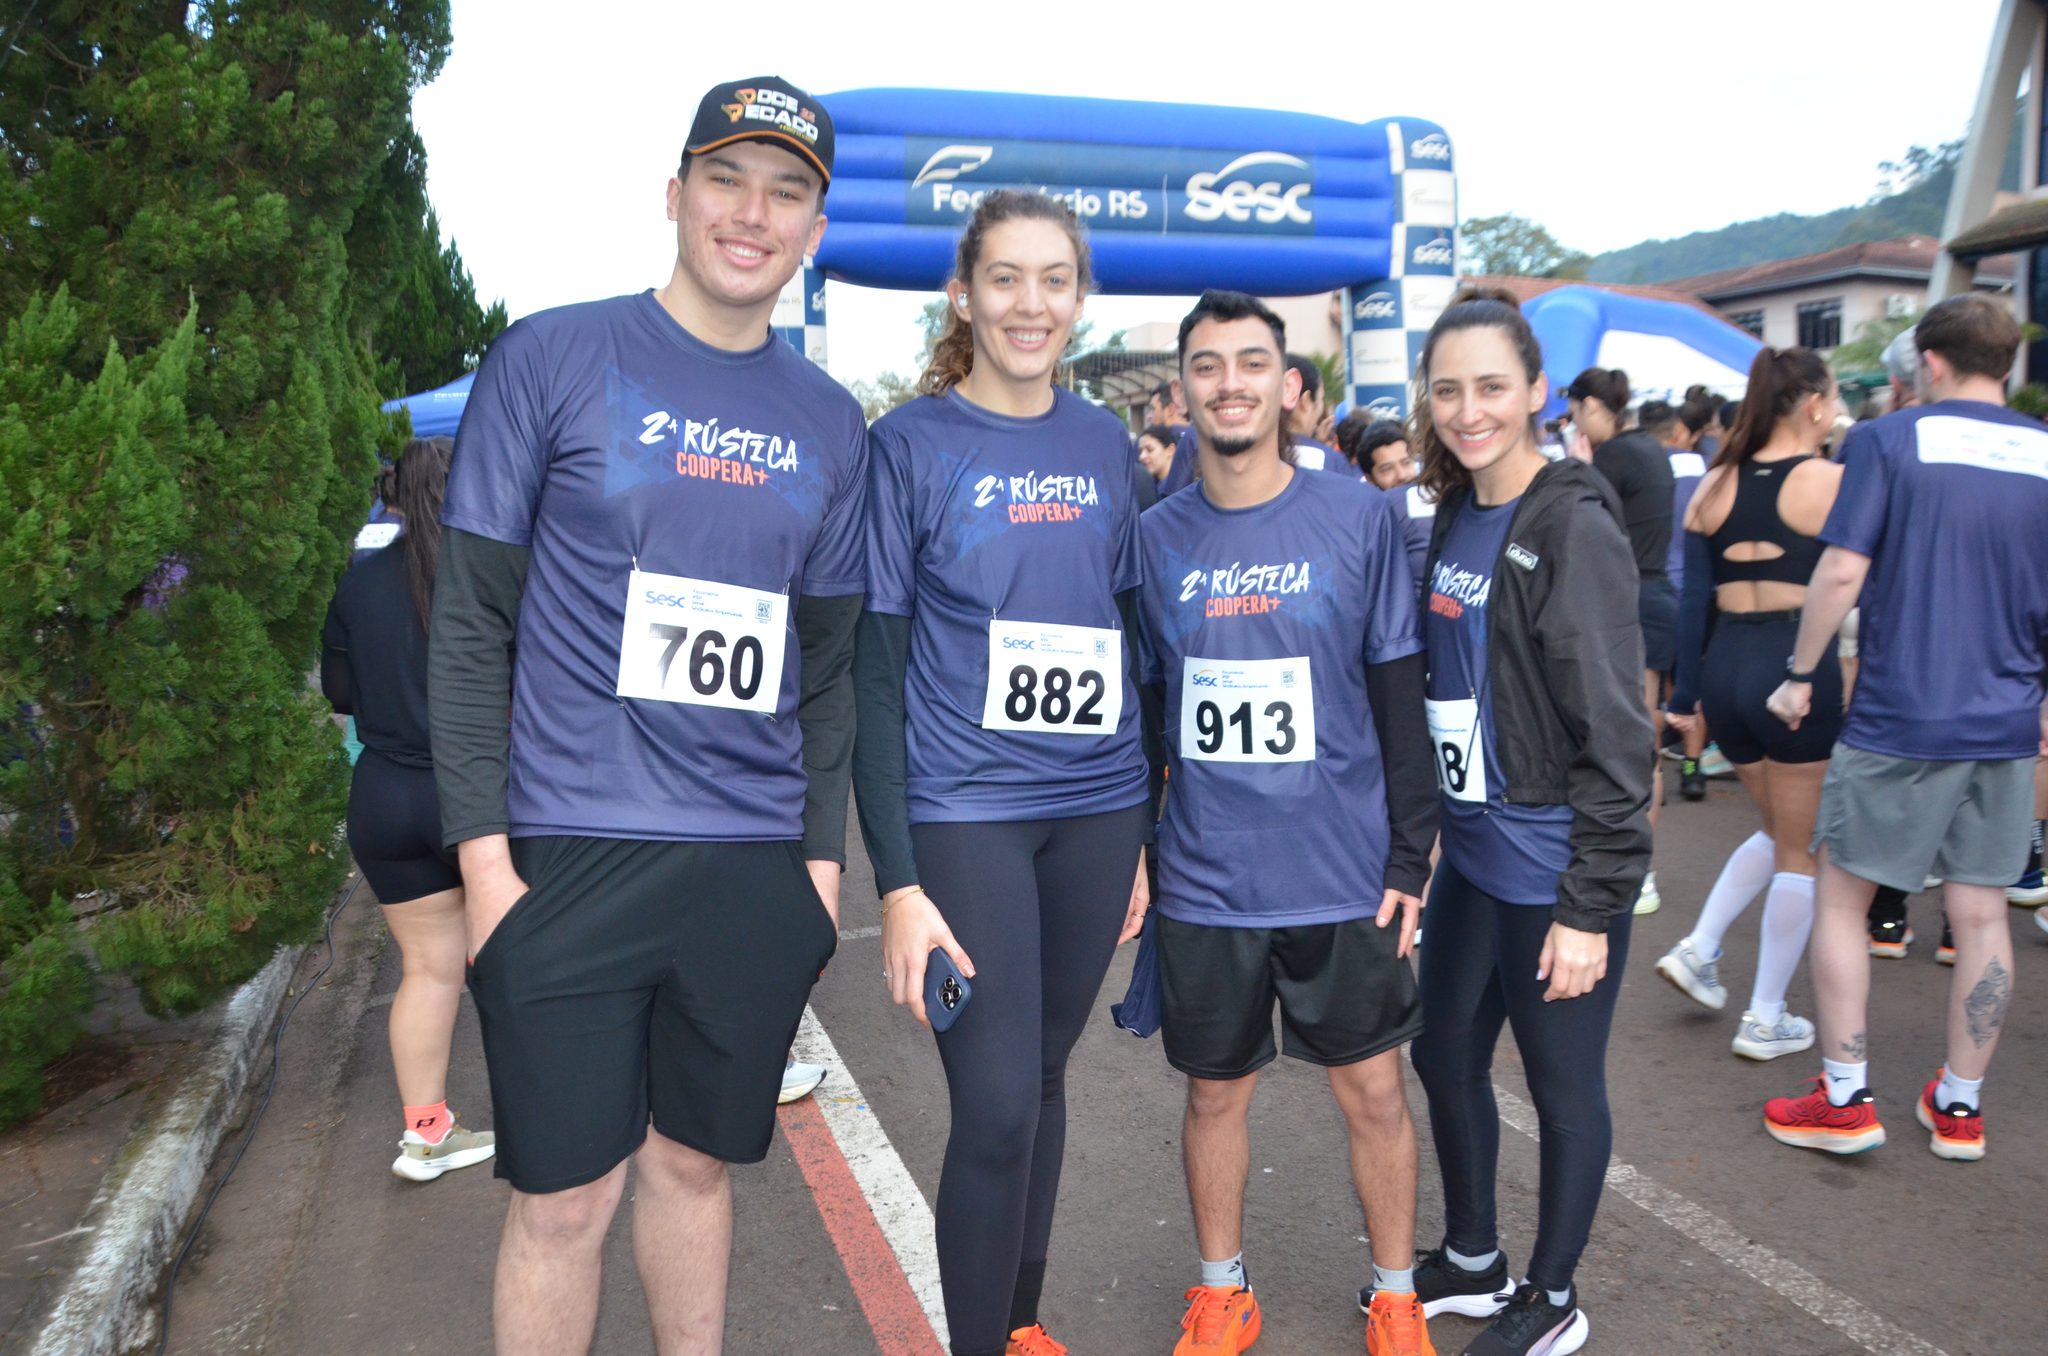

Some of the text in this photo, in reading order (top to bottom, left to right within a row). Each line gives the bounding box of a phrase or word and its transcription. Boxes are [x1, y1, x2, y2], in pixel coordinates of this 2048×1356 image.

[1108, 190, 1148, 219] RS
[684, 417, 799, 473] RÚSTICA
[676, 451, 771, 486] COOPERA+
[1009, 470, 1098, 506] RÚSTICA
[1008, 502, 1083, 523] COOPERA+
[1211, 561, 1311, 599] RÚSTICA
[1205, 594, 1282, 618] COOPERA+
[649, 622, 764, 701] 760
[1005, 664, 1105, 725] 882
[1196, 700, 1296, 755] 913
